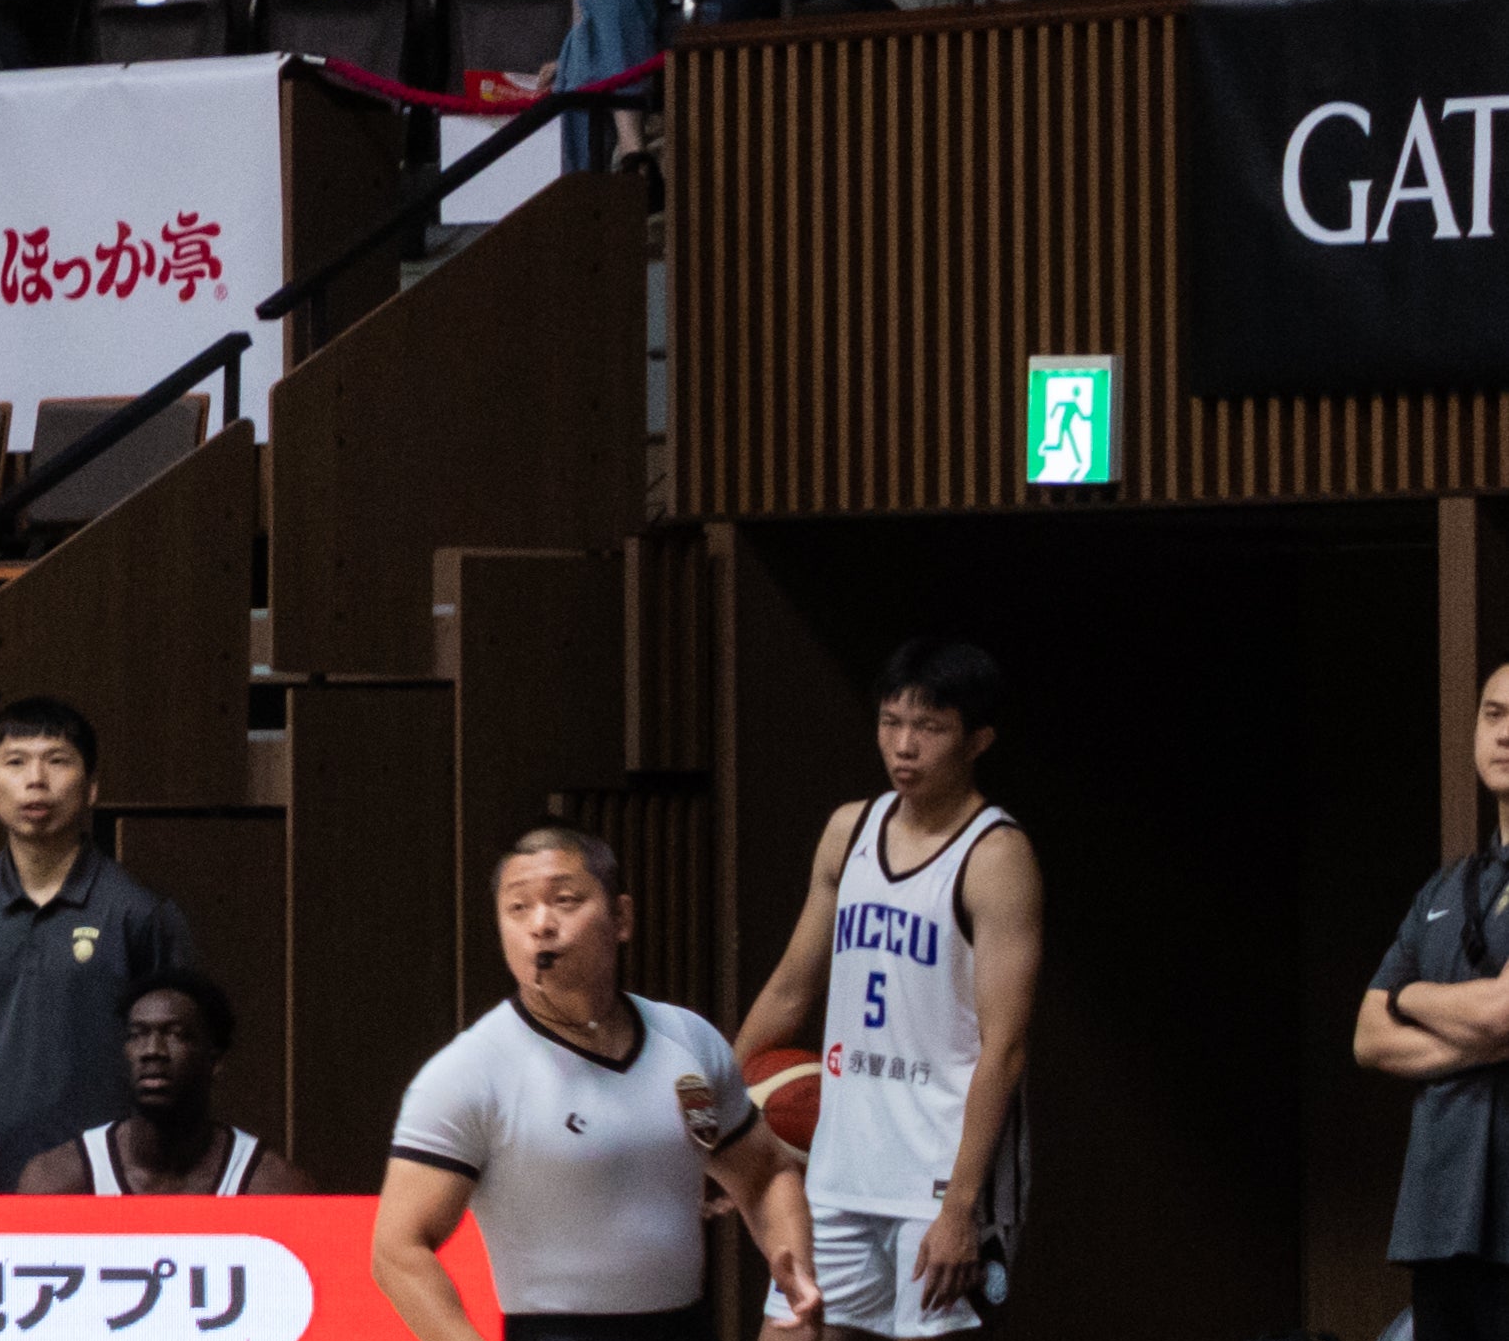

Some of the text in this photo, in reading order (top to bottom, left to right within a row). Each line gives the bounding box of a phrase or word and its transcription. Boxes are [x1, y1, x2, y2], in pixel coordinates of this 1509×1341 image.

[1280, 95, 1509, 247] GAT
[835, 901, 939, 969] NCCU
[863, 971, 888, 1029] 5
